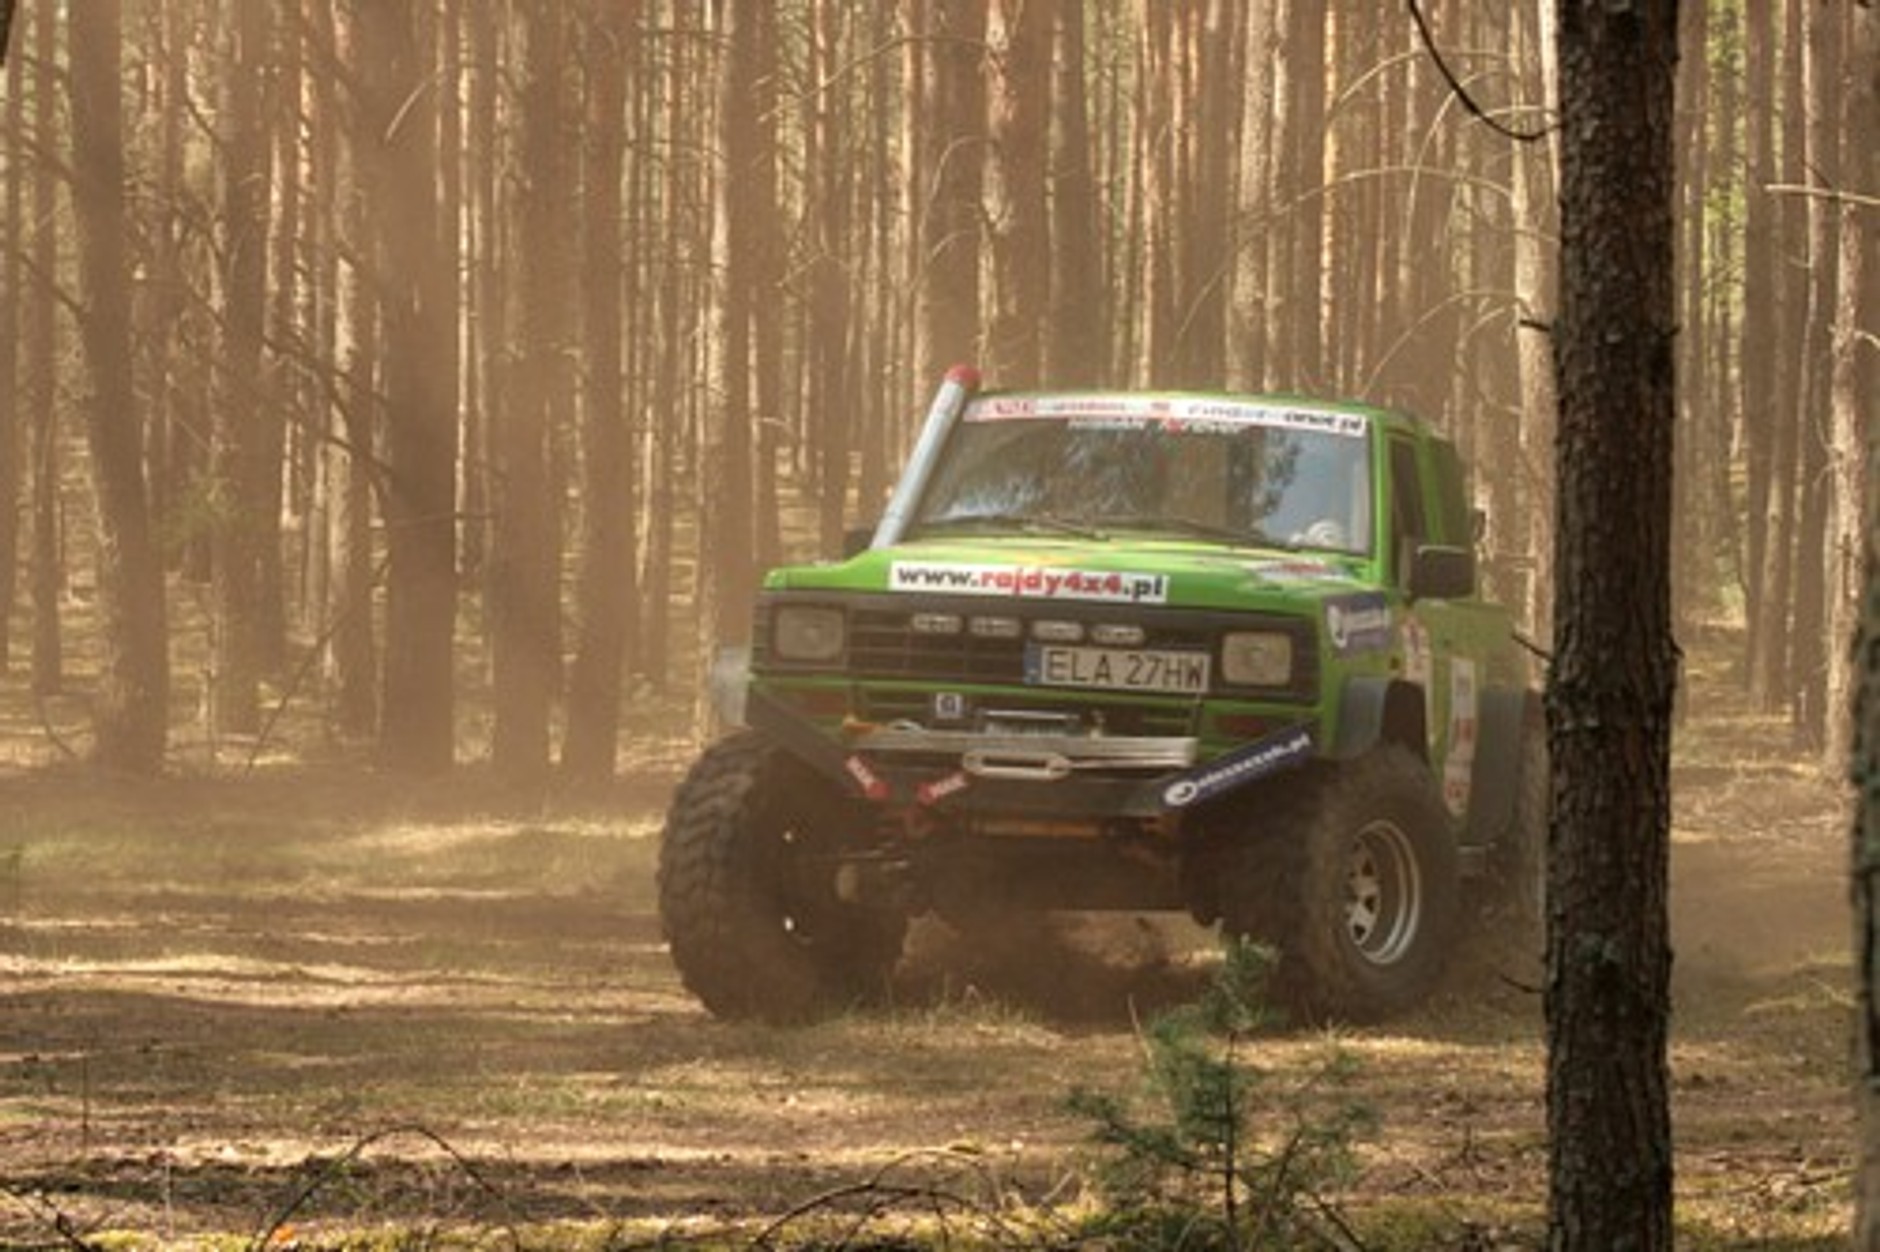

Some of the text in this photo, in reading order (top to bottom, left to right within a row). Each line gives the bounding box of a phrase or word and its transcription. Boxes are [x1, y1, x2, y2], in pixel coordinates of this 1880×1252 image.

[897, 566, 1163, 601] www.rajdy4x4.pl
[1046, 650, 1204, 691] ELA 27HW
